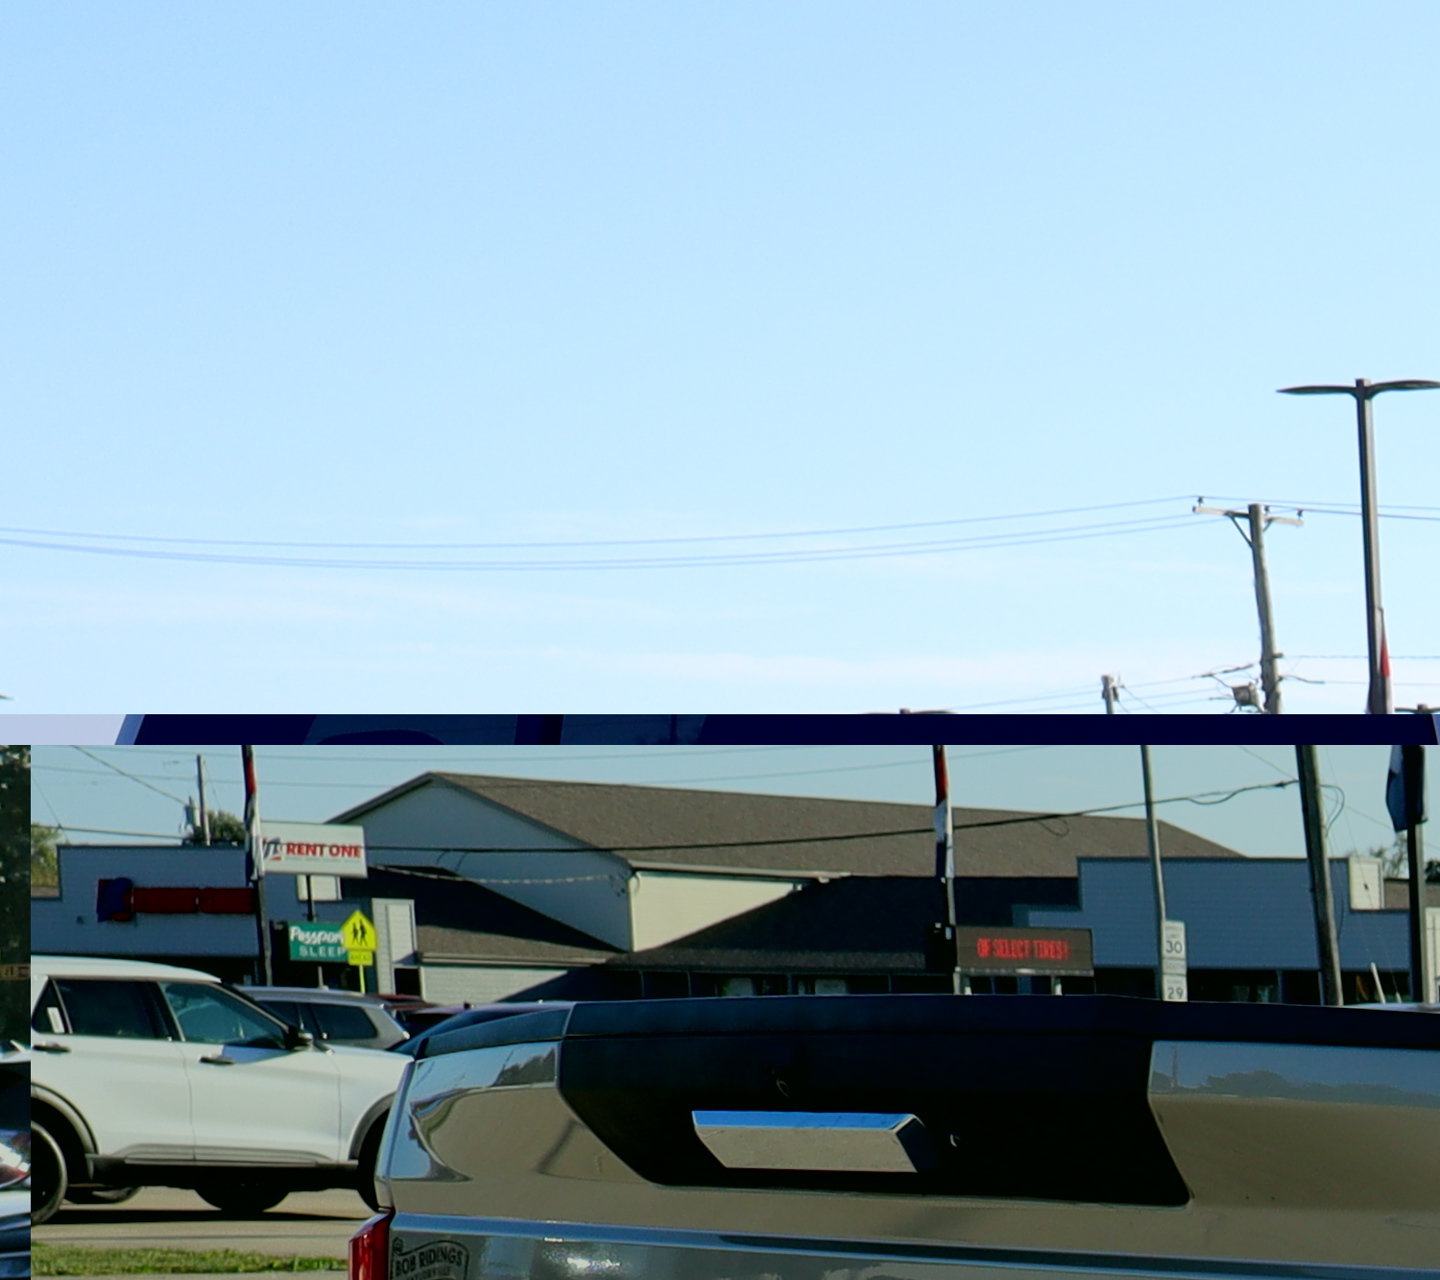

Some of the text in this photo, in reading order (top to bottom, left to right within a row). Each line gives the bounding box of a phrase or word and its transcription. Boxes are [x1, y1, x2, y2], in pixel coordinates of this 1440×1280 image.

[286, 842, 361, 858] RENT ONE
[1166, 940, 1183, 953] 30
[1167, 986, 1184, 999] 29
[395, 1245, 463, 1277] BOB RIDINGS
